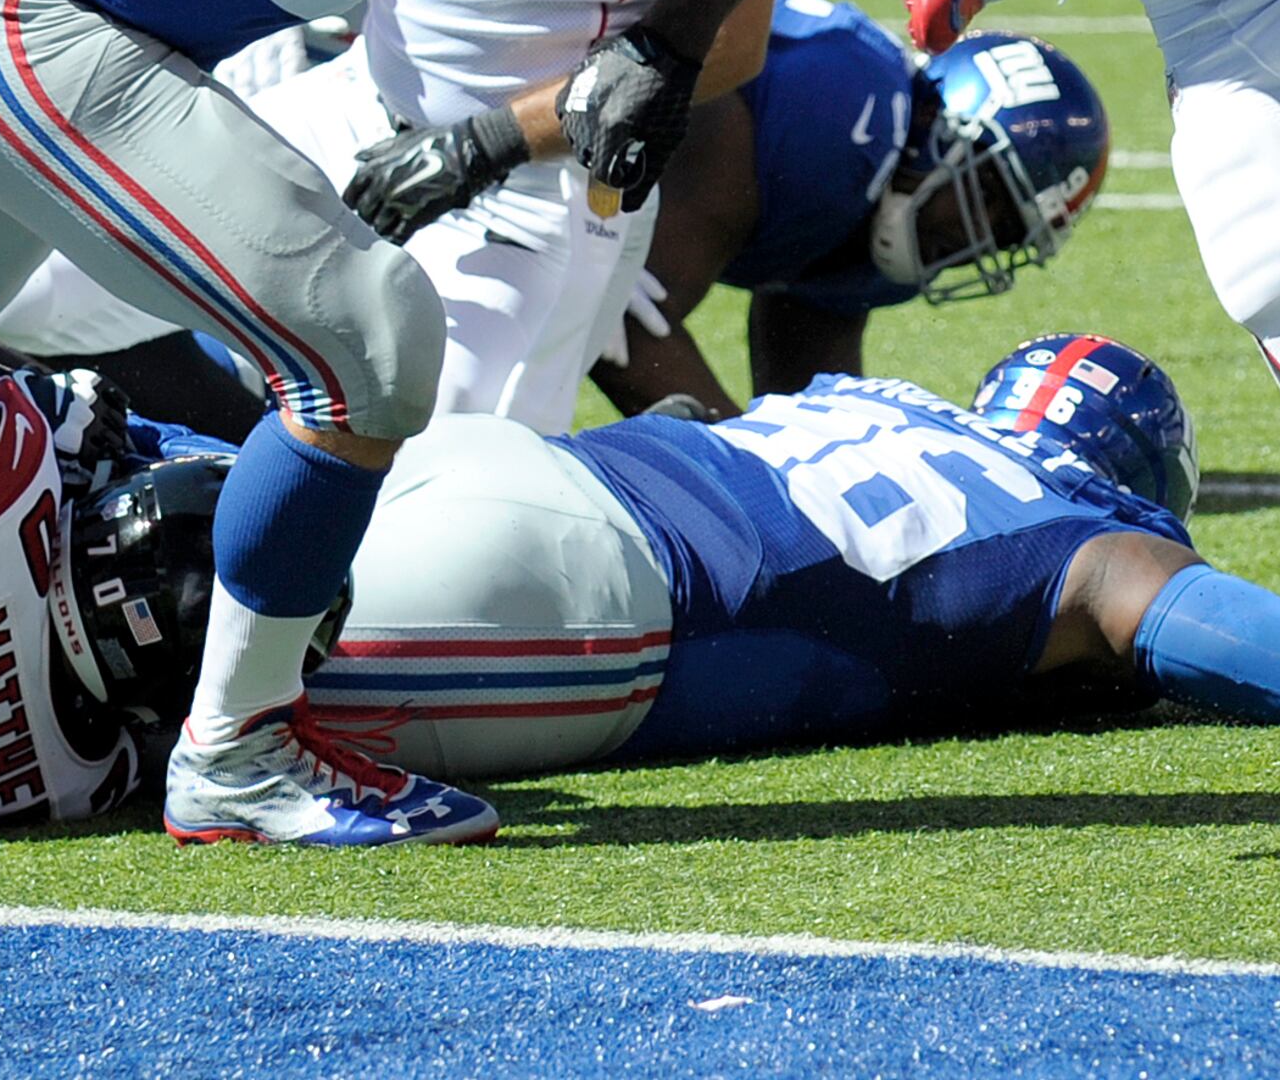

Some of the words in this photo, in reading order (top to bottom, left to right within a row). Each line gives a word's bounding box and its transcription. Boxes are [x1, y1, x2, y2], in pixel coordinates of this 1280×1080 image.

[1004, 366, 1084, 425] 96
[712, 392, 1044, 582] 96
[87, 533, 127, 607] 70
